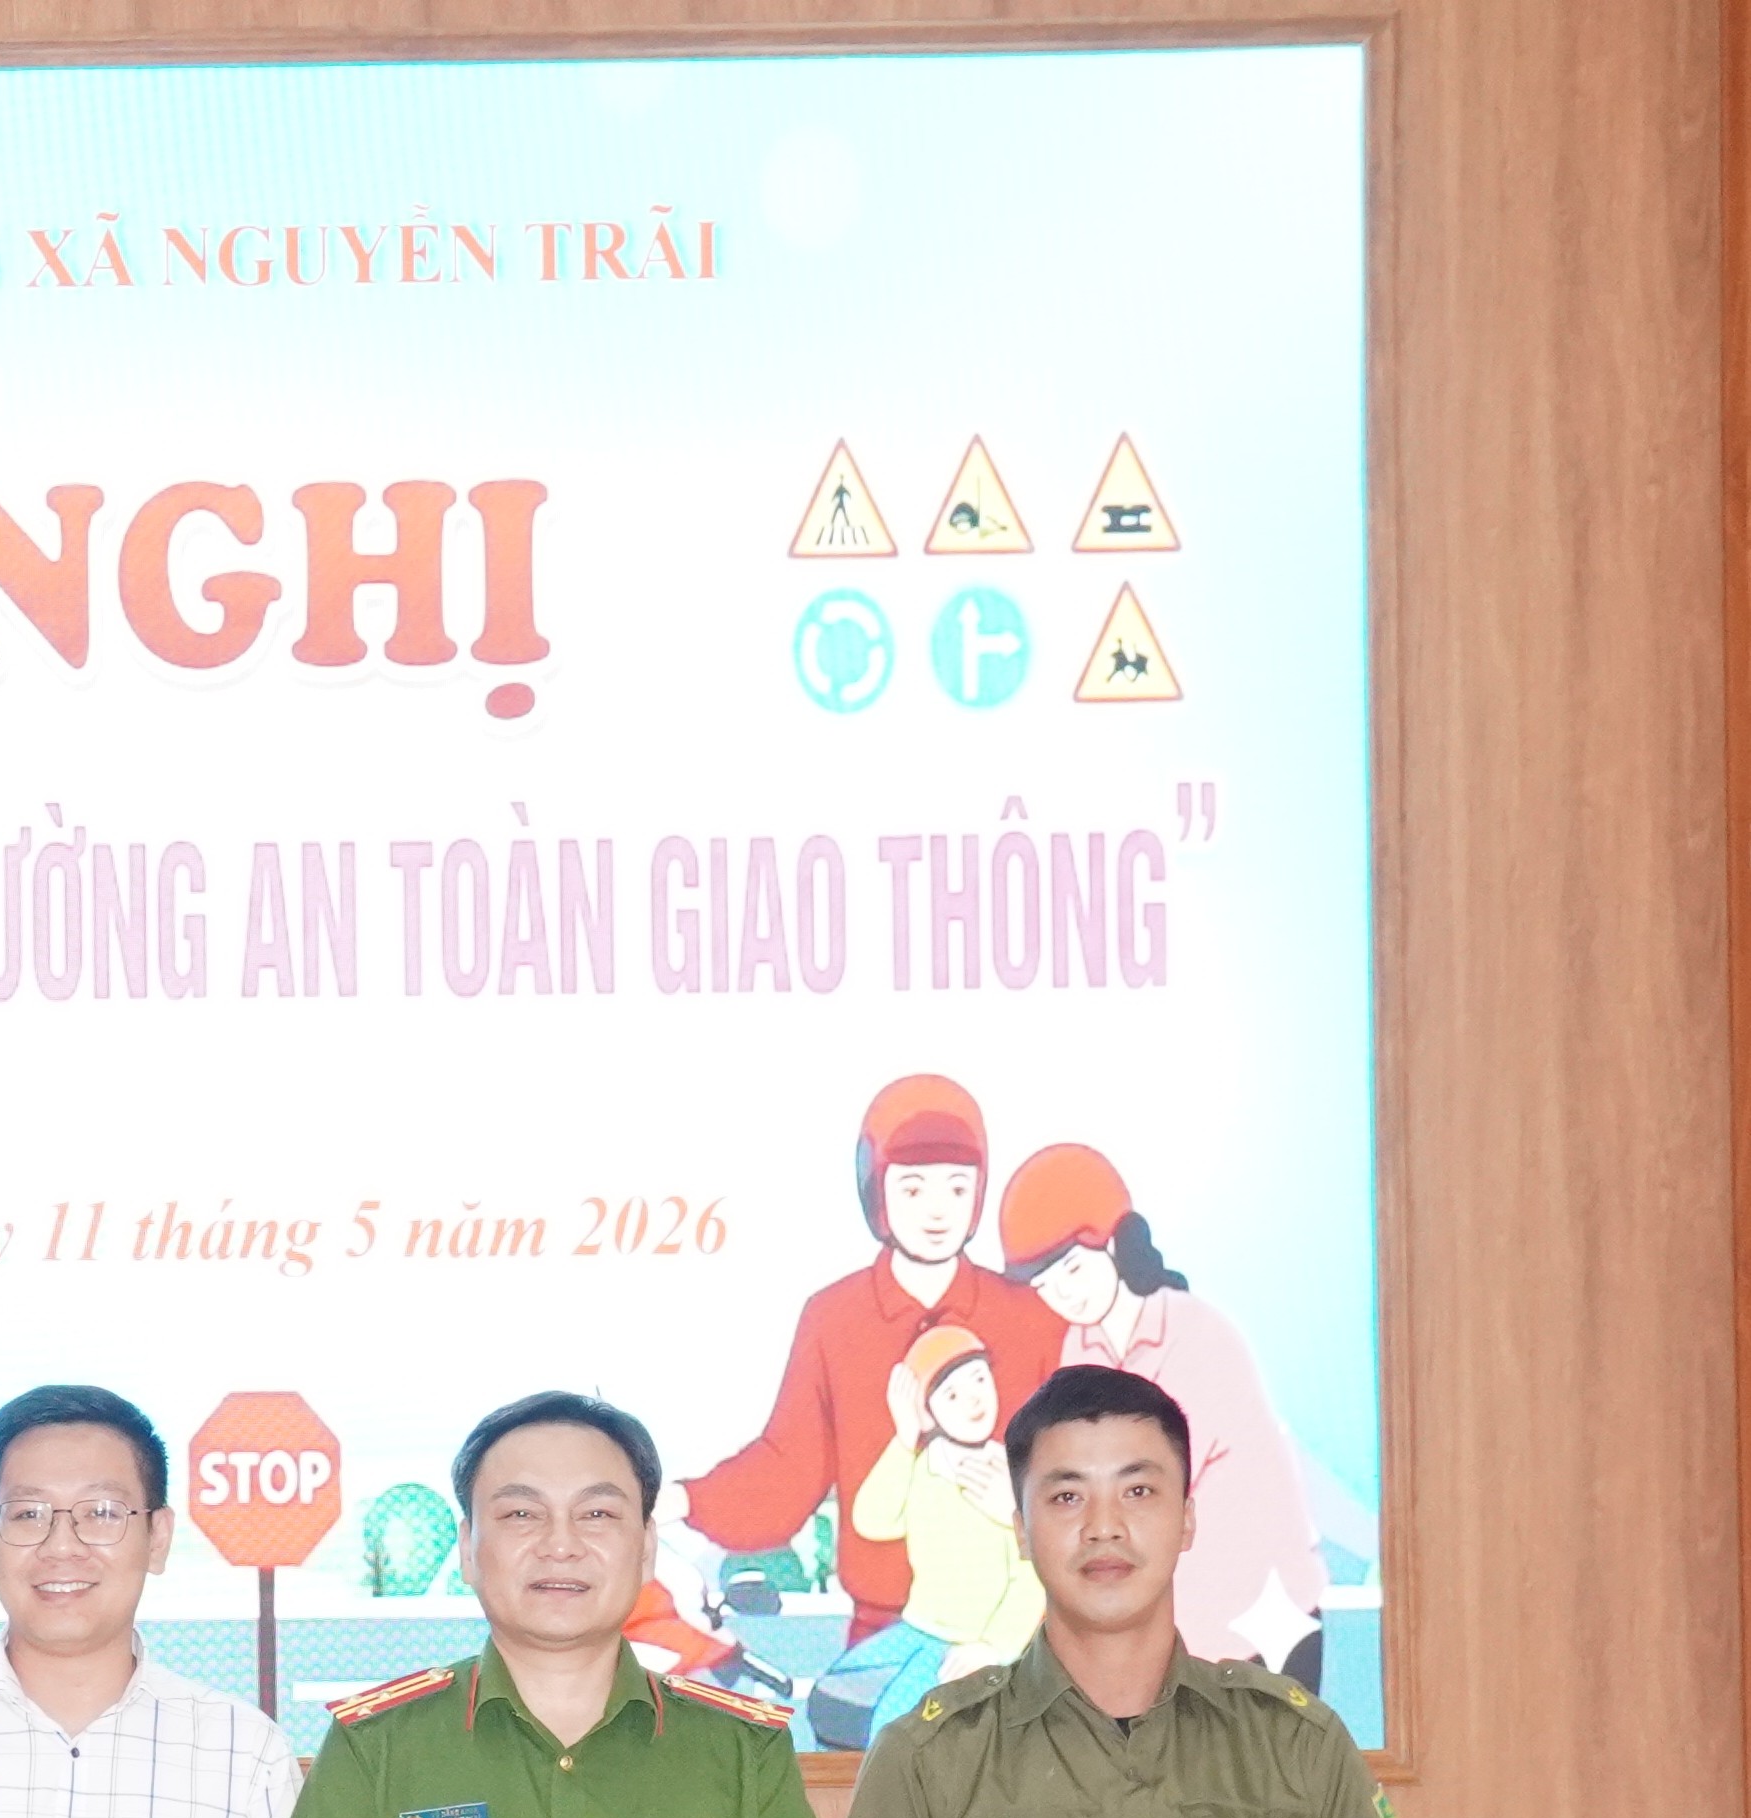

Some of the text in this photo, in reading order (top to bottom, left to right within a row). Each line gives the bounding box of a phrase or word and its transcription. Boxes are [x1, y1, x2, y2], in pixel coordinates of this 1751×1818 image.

[24, 211, 135, 289] XÃ
[161, 204, 498, 287] NGUYỄN
[523, 204, 718, 283] TRÃI
[240, 841, 358, 999] AN
[388, 800, 616, 999] TOÀN
[649, 834, 846, 995] GIAO
[878, 781, 1216, 991] THÔNG”
[41, 1200, 107, 1262] 11
[130, 1197, 323, 1278] tháng
[344, 1200, 382, 1259] 5
[403, 1199, 547, 1260] năm
[570, 1195, 729, 1258] 2026
[198, 1449, 333, 1506] STOP
